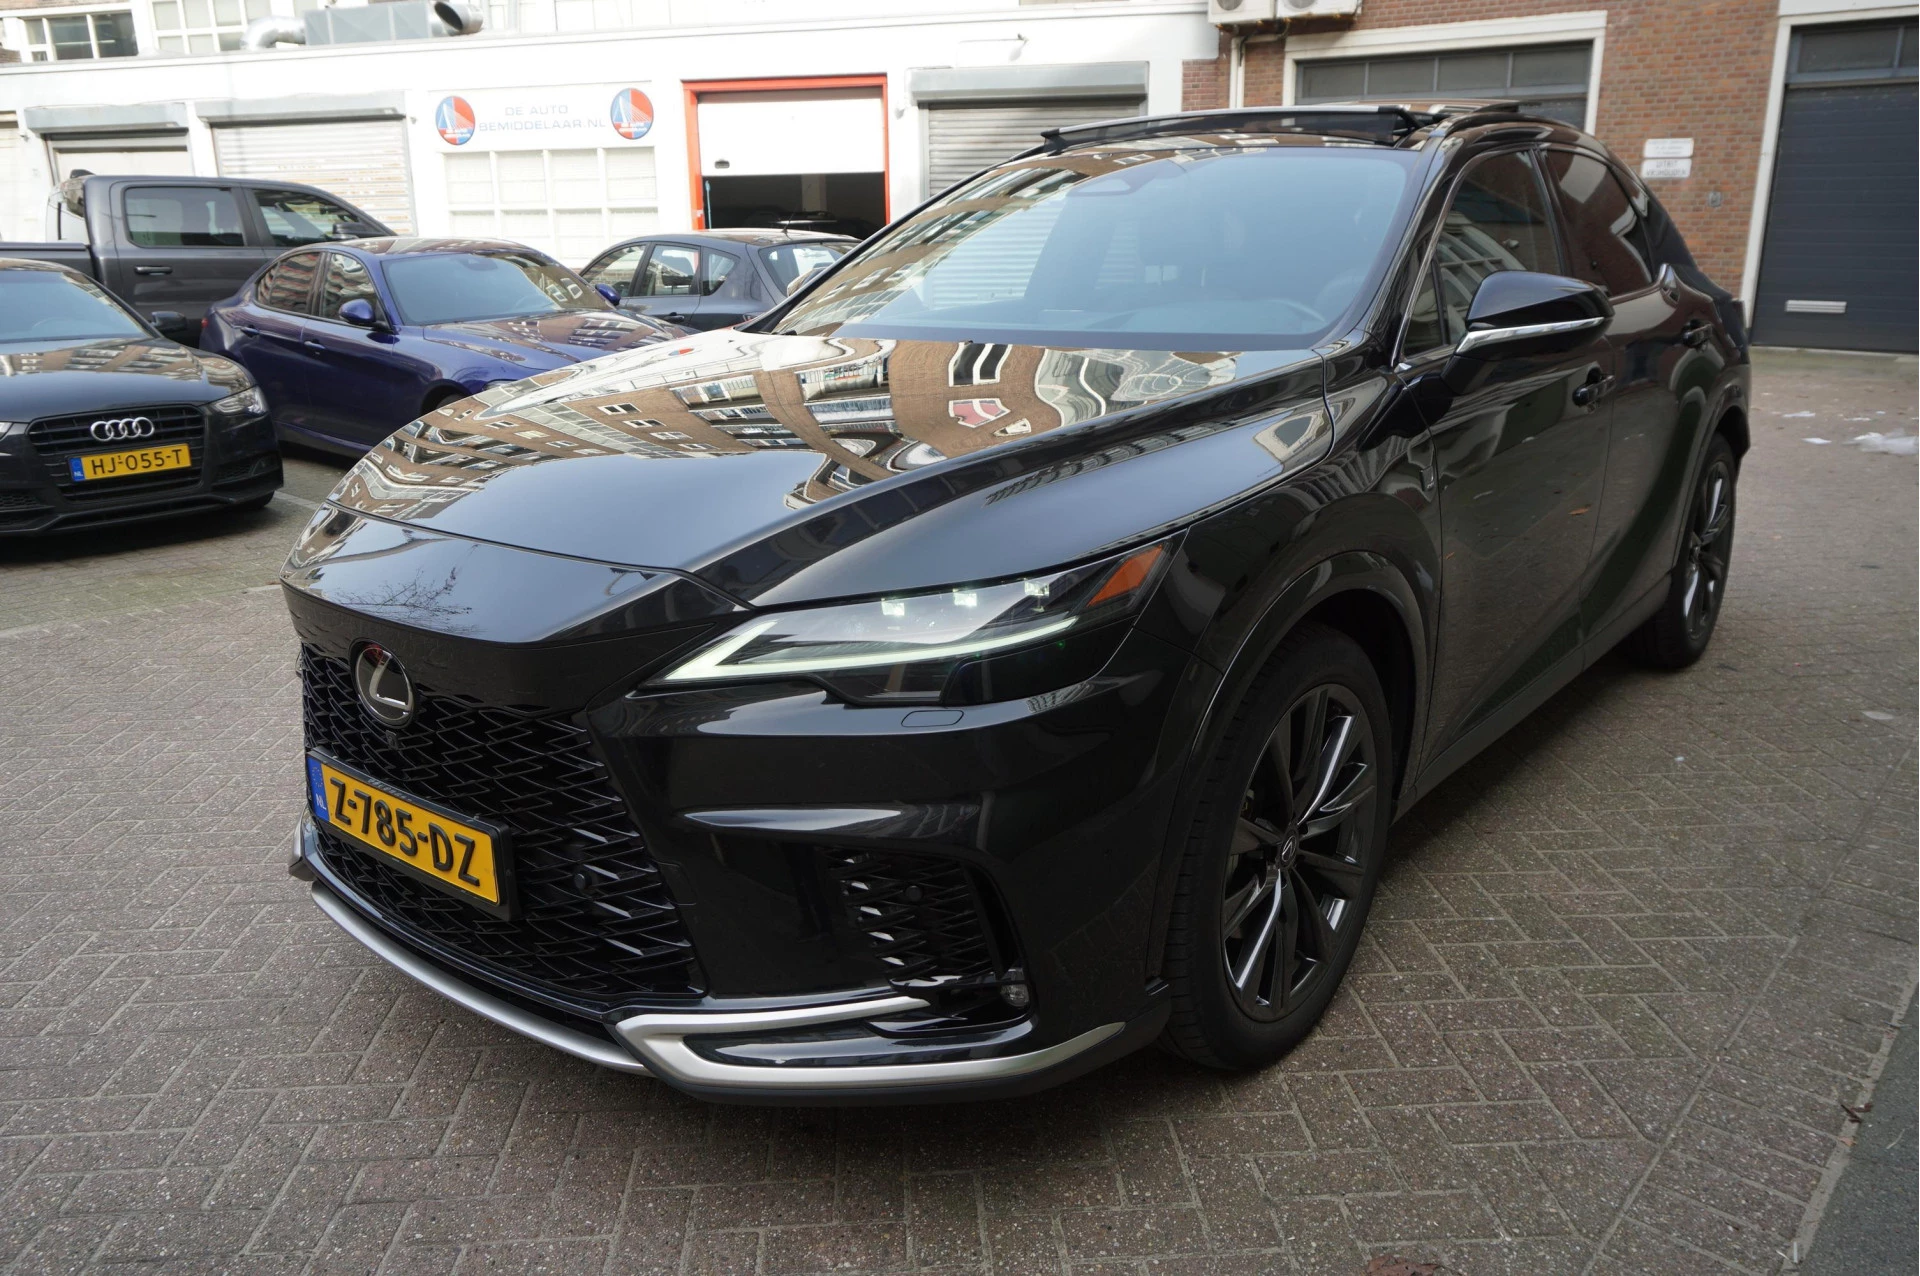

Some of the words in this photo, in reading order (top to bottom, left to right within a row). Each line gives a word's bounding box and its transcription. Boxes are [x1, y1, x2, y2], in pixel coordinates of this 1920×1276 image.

[504, 106, 524, 116] DE
[529, 104, 569, 115] AUTO
[478, 118, 606, 132] BEMIDDELAAR.NL
[91, 449, 182, 475] HJ-055-T
[315, 793, 327, 811] NL
[330, 777, 480, 887] Z-785-DZ
